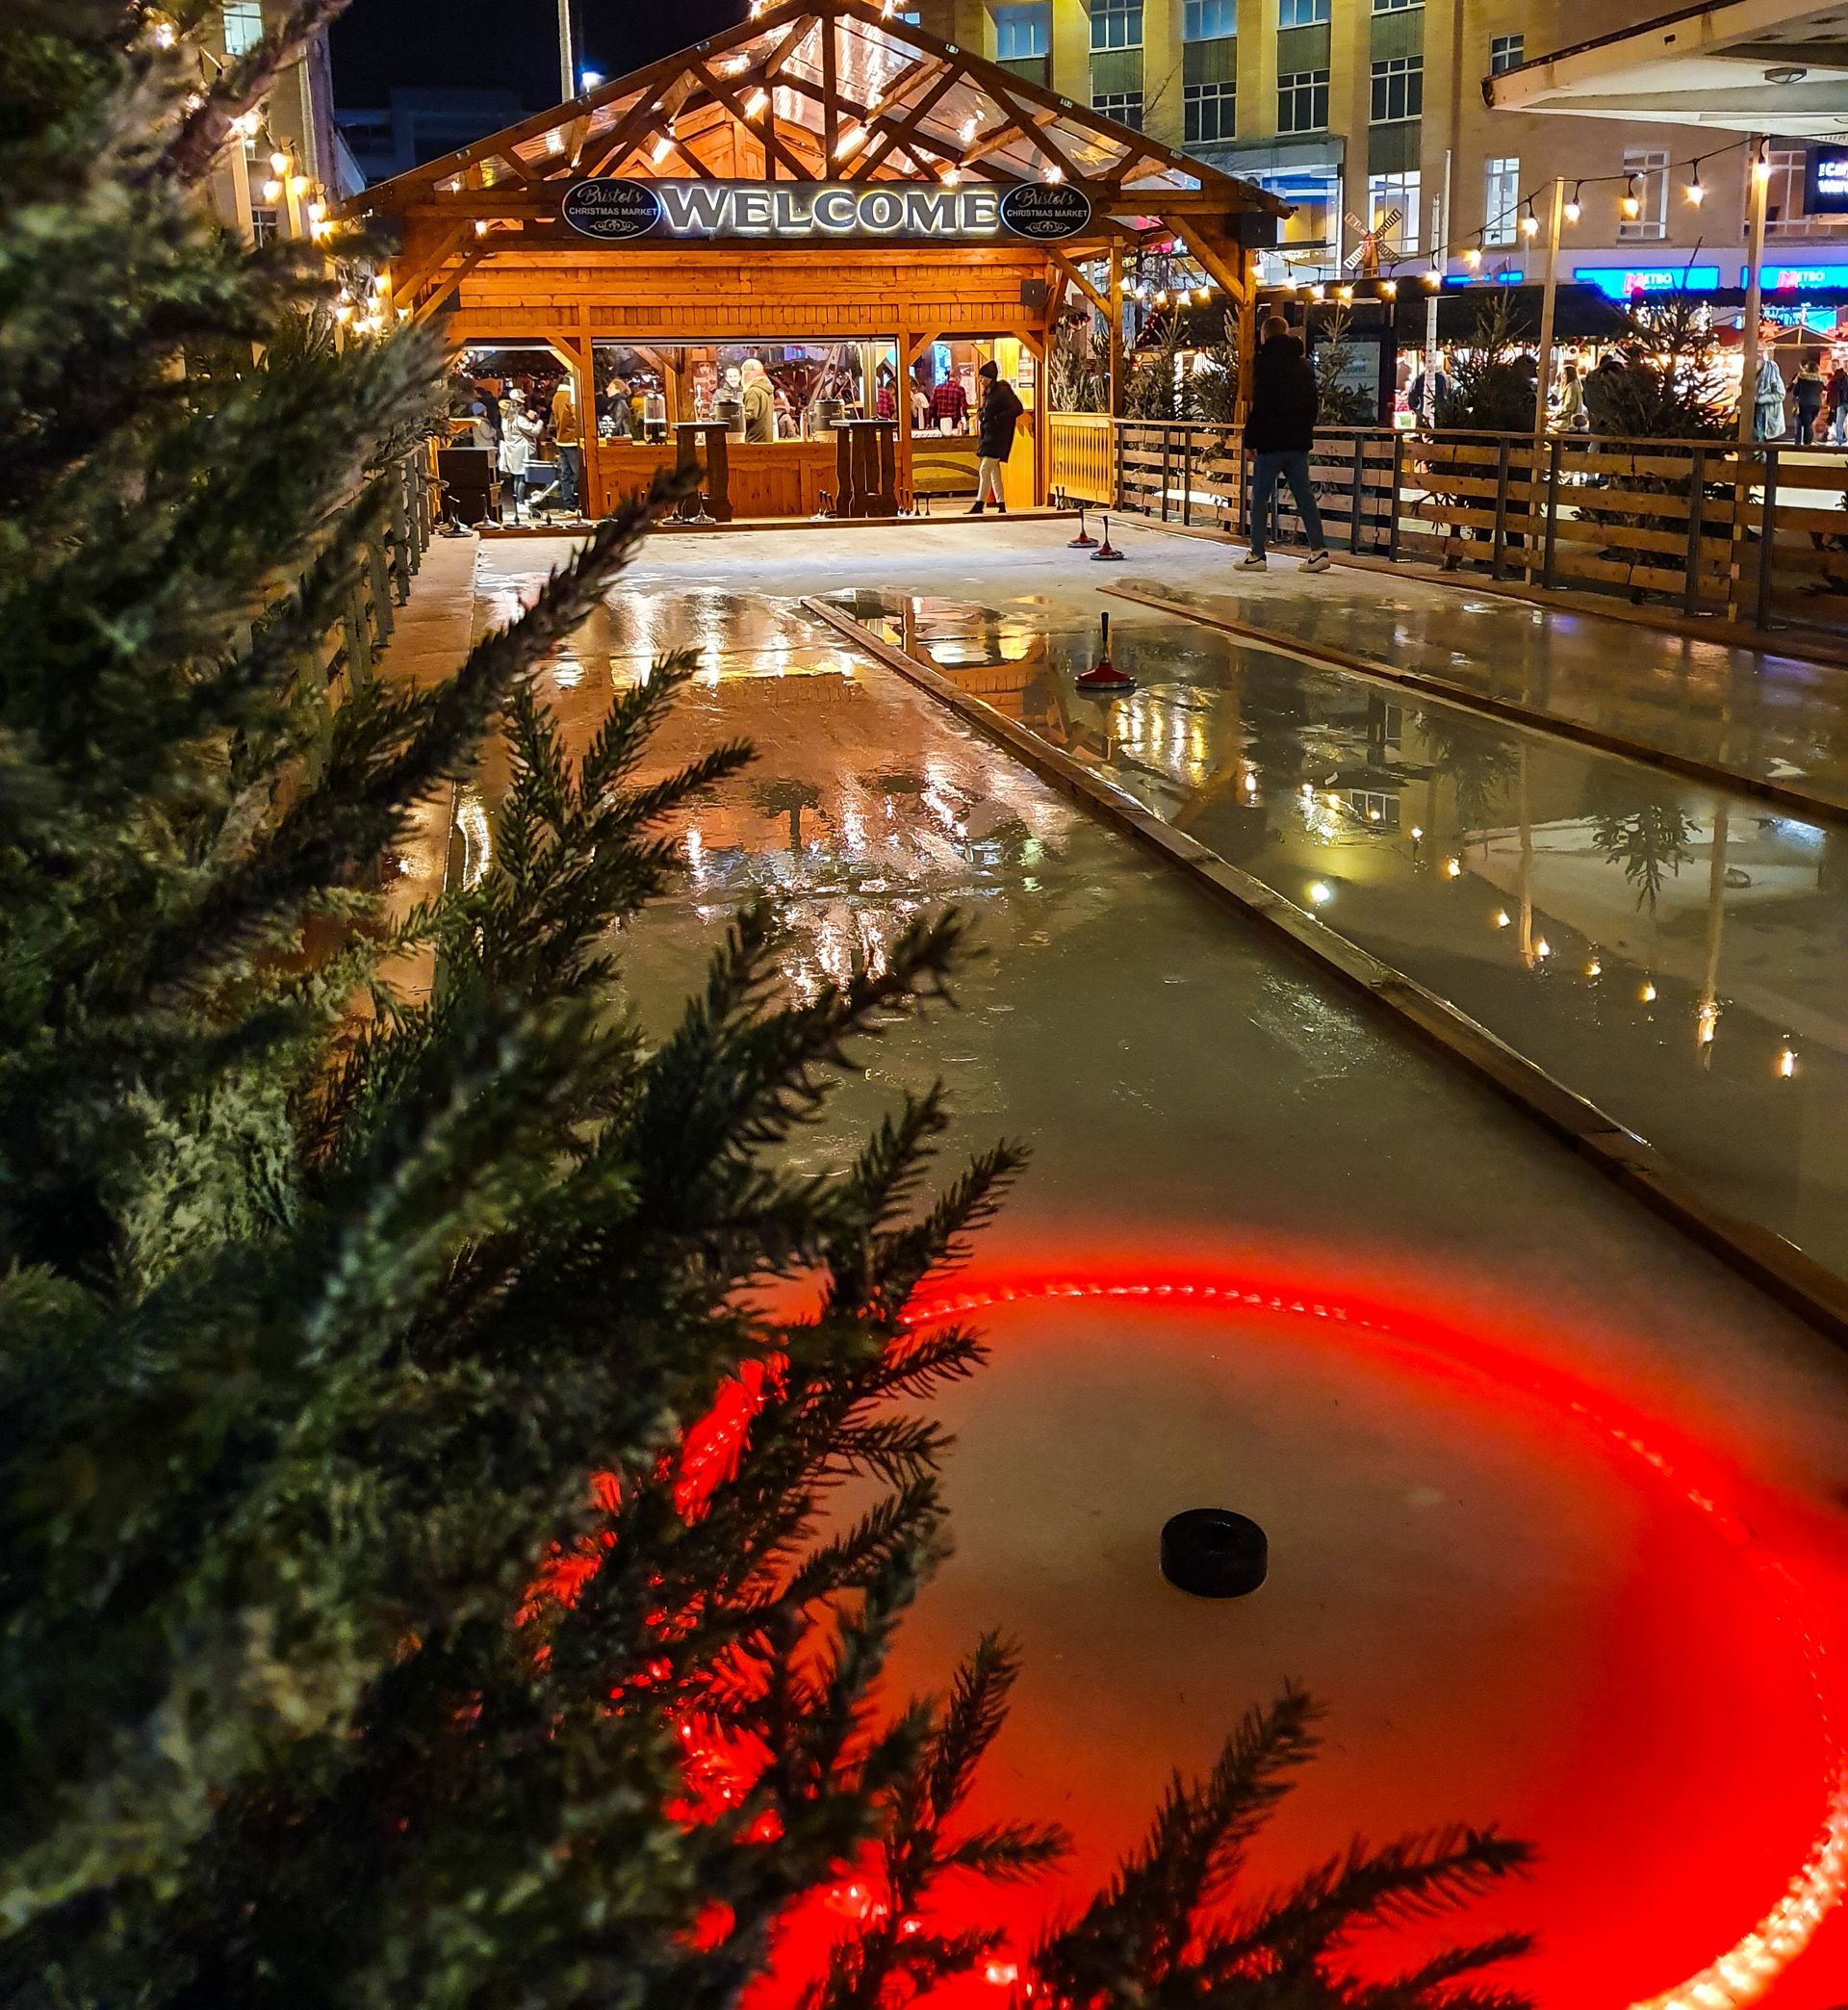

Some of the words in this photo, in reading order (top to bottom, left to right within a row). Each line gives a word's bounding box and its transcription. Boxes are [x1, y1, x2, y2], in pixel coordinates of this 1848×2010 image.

[577, 184, 644, 206] Bristol's
[1014, 188, 1076, 208] Bristol's
[568, 207, 620, 217] CHRISTMAS
[621, 207, 657, 217] MARKET
[660, 188, 998, 230] WELCOME
[1006, 209, 1054, 218] CHRISTMAS
[1054, 209, 1088, 218] MARKET
